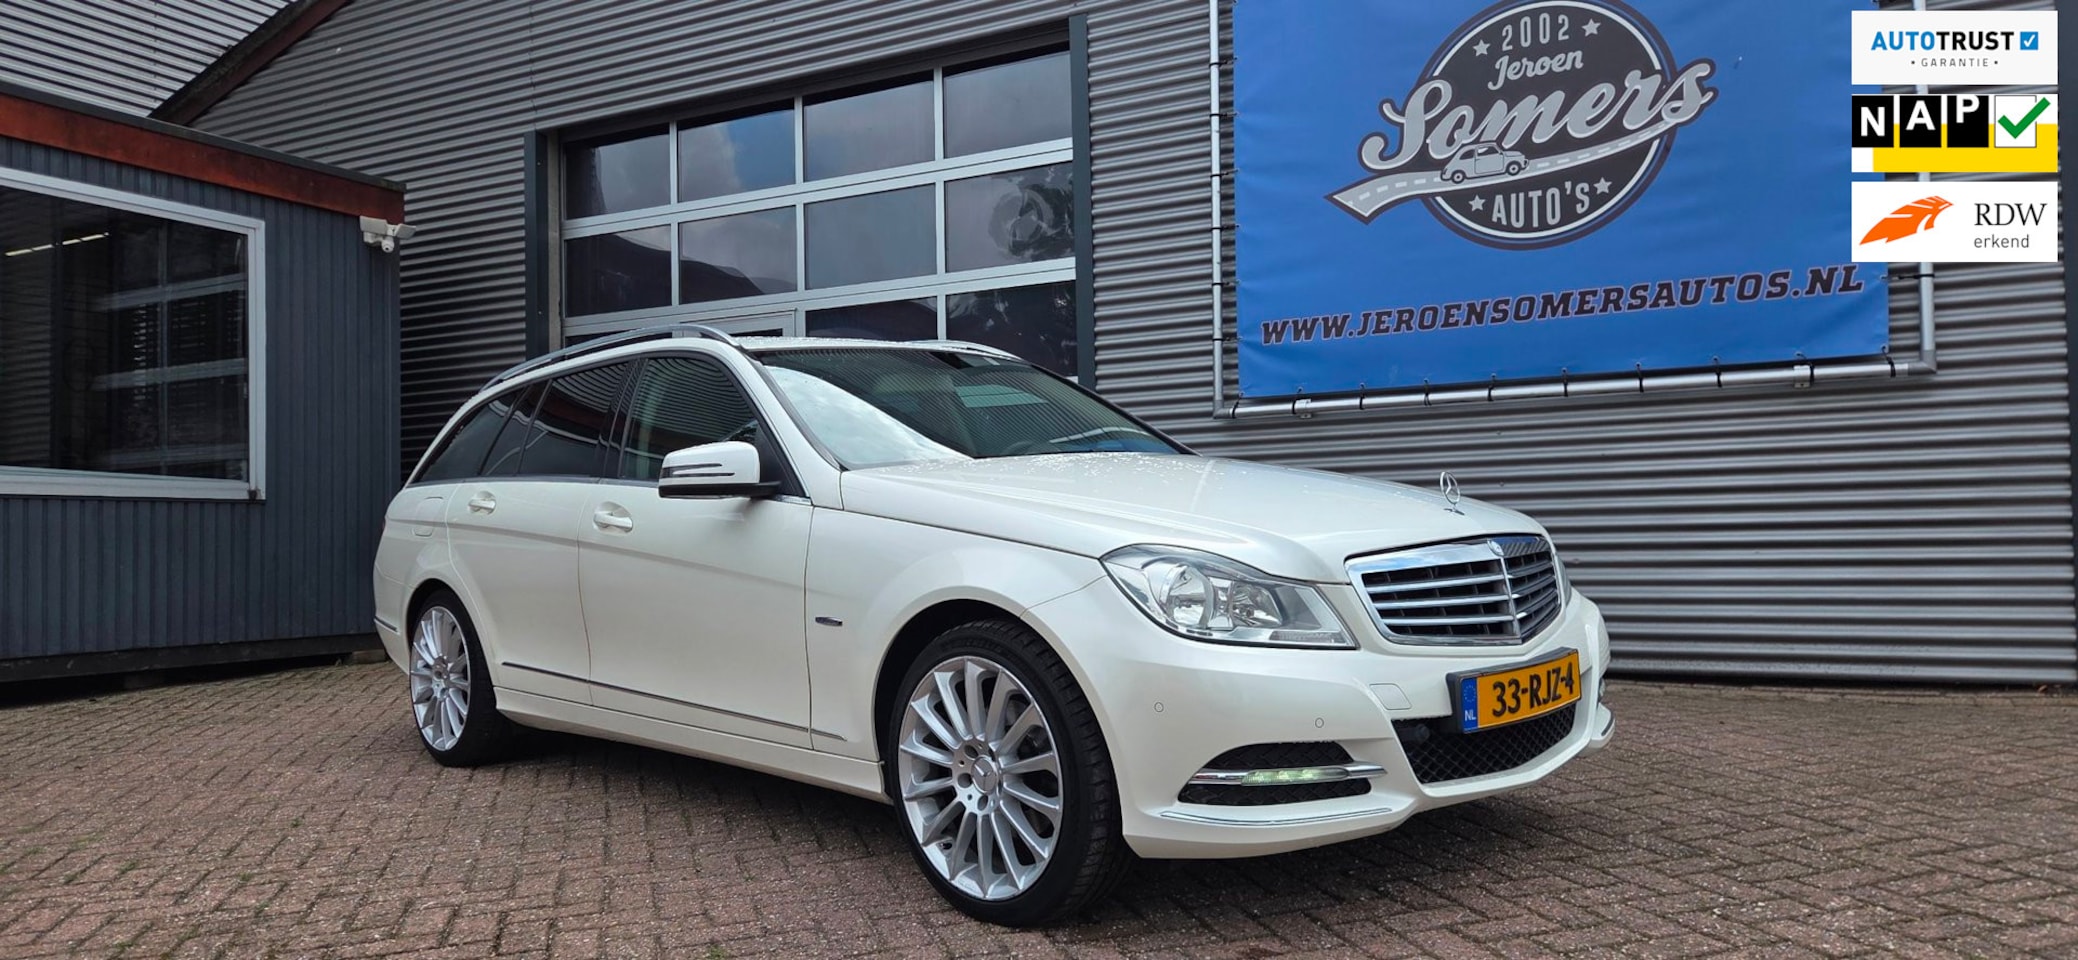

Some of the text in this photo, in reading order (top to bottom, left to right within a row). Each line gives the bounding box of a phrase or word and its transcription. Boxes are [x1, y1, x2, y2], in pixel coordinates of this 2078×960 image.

[1501, 13, 1572, 53] 2002
[1488, 49, 1584, 90] Jeroen
[1362, 63, 1714, 171] Somers
[1260, 264, 1865, 345] WWW.JEROENSOMERSAUTOS.NL
[1492, 661, 1574, 717] 33-RJZ-4
[1464, 709, 1476, 722] NL
